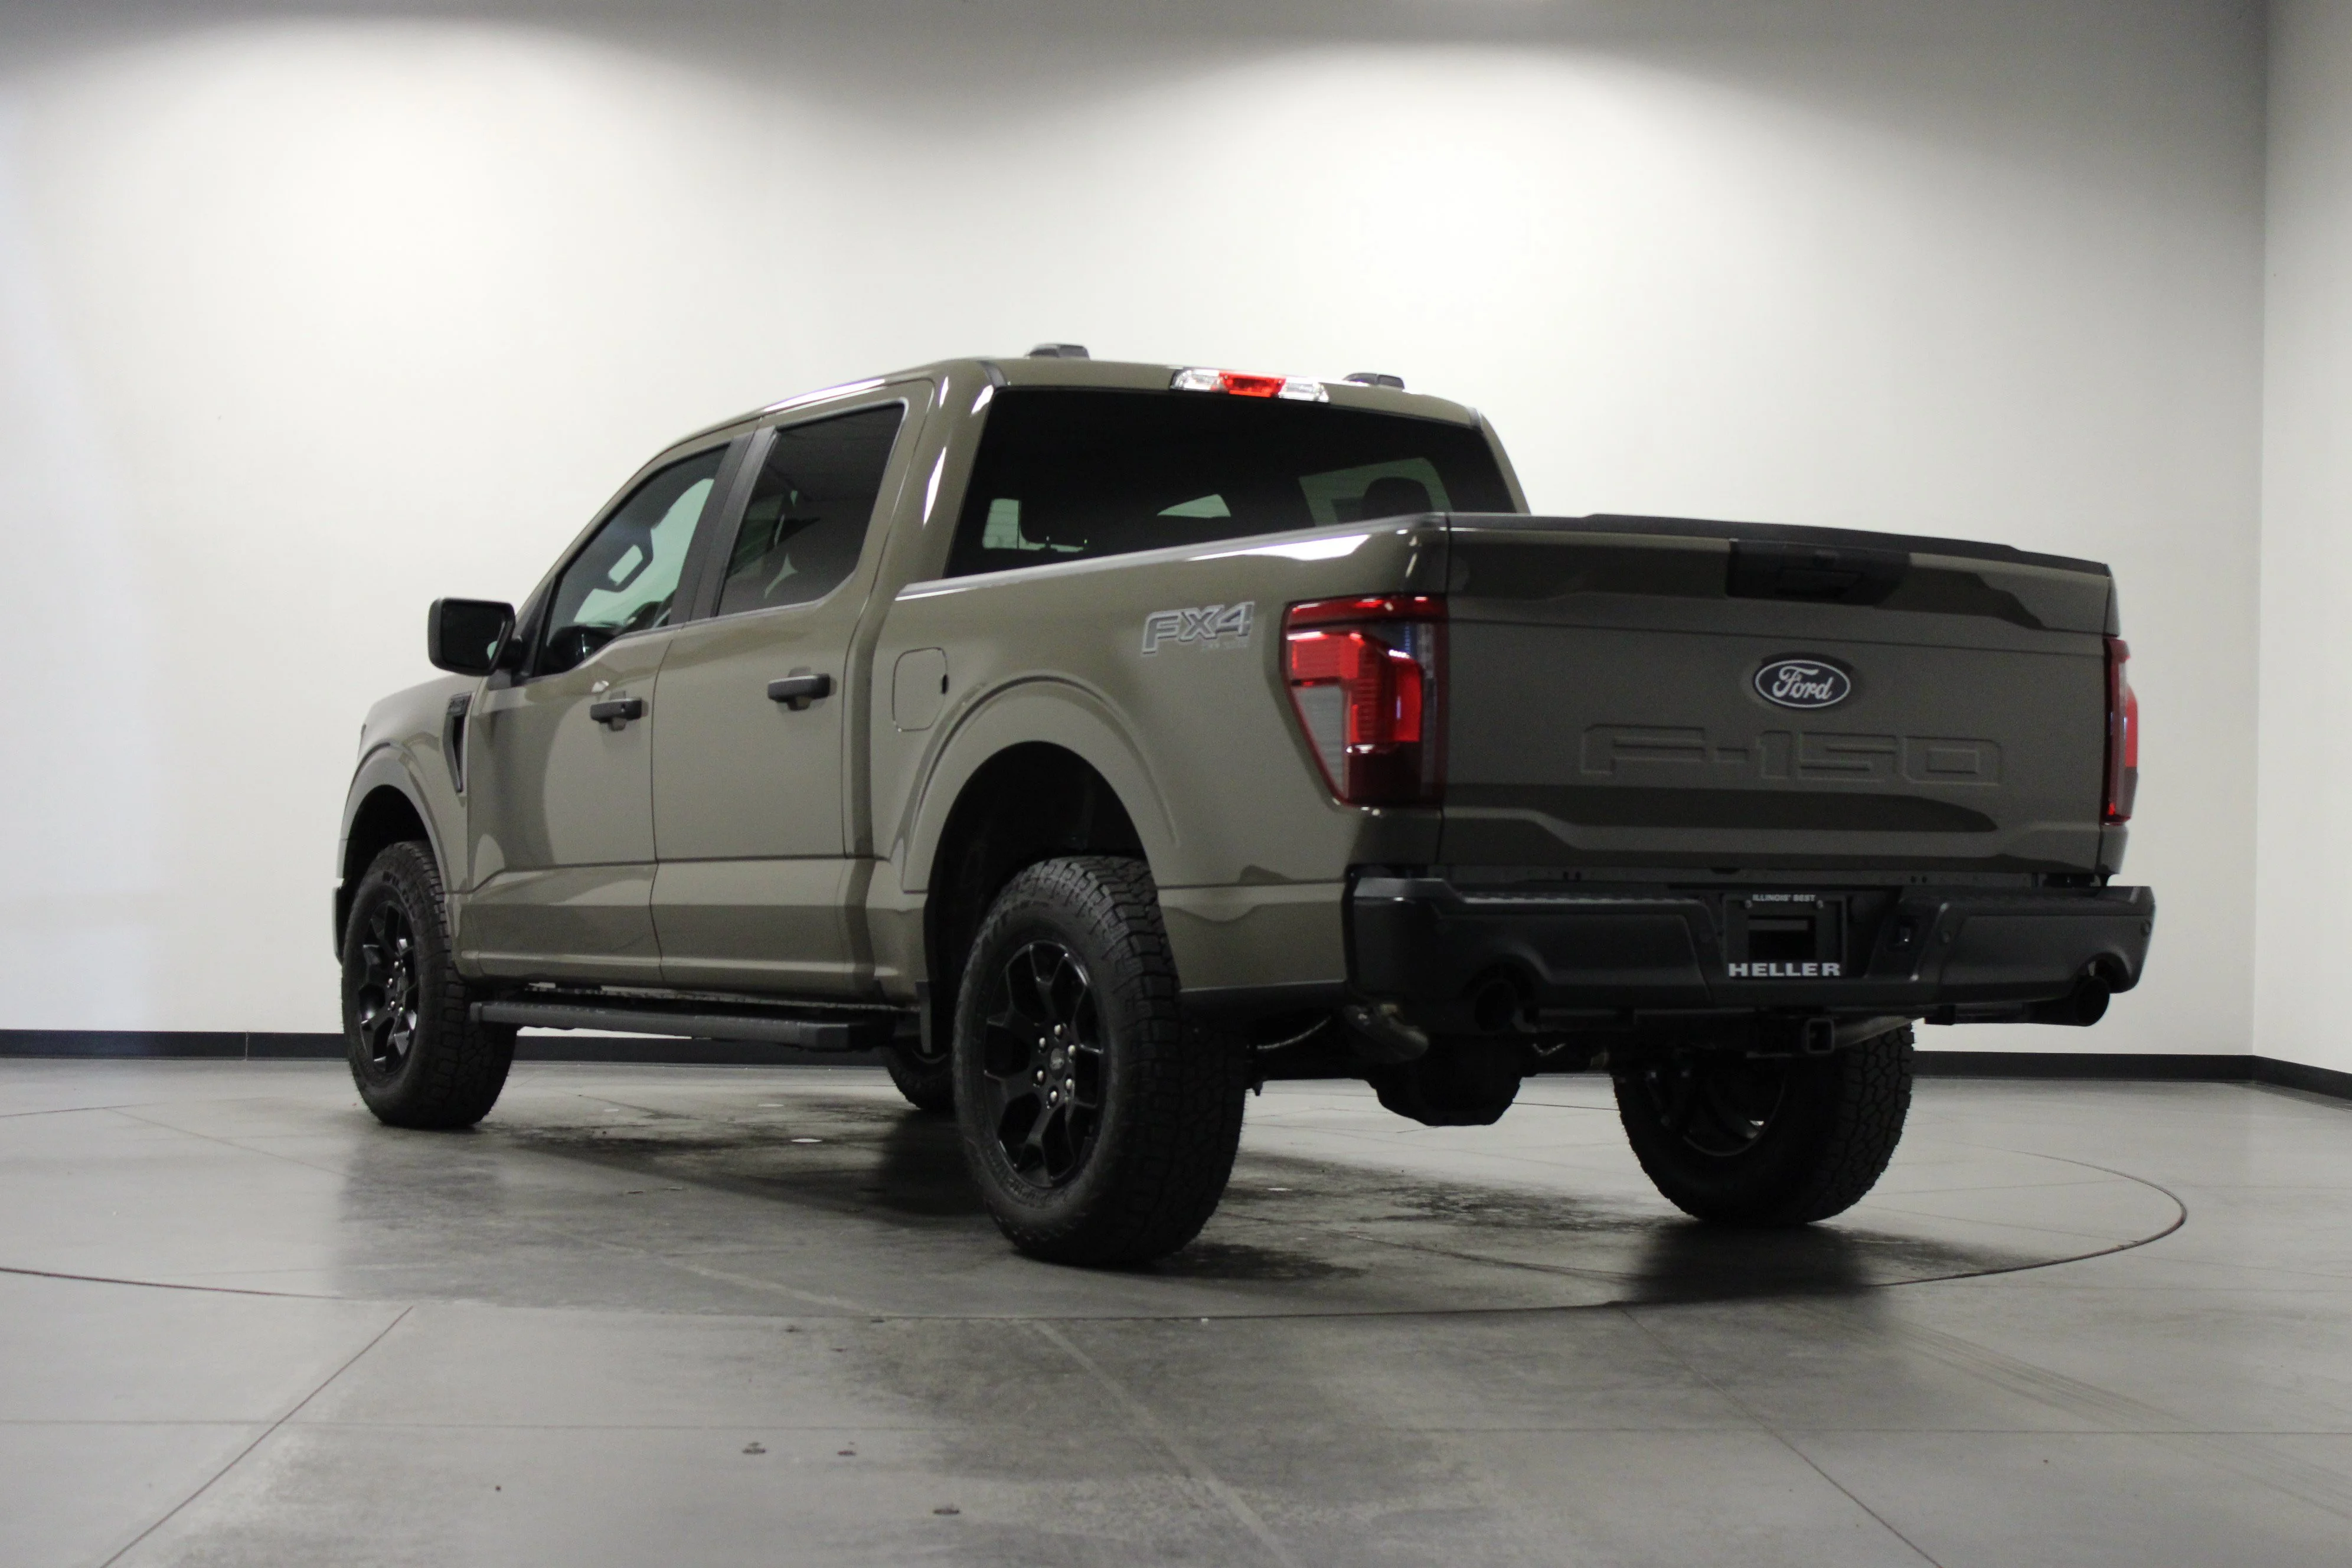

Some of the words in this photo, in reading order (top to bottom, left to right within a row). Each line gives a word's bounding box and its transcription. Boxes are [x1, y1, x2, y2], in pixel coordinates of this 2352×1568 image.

[1142, 601, 1255, 655] FX4
[1772, 665, 1835, 700] Ford
[1580, 723, 2002, 787] F-150
[1728, 962, 1841, 976] HELLER
